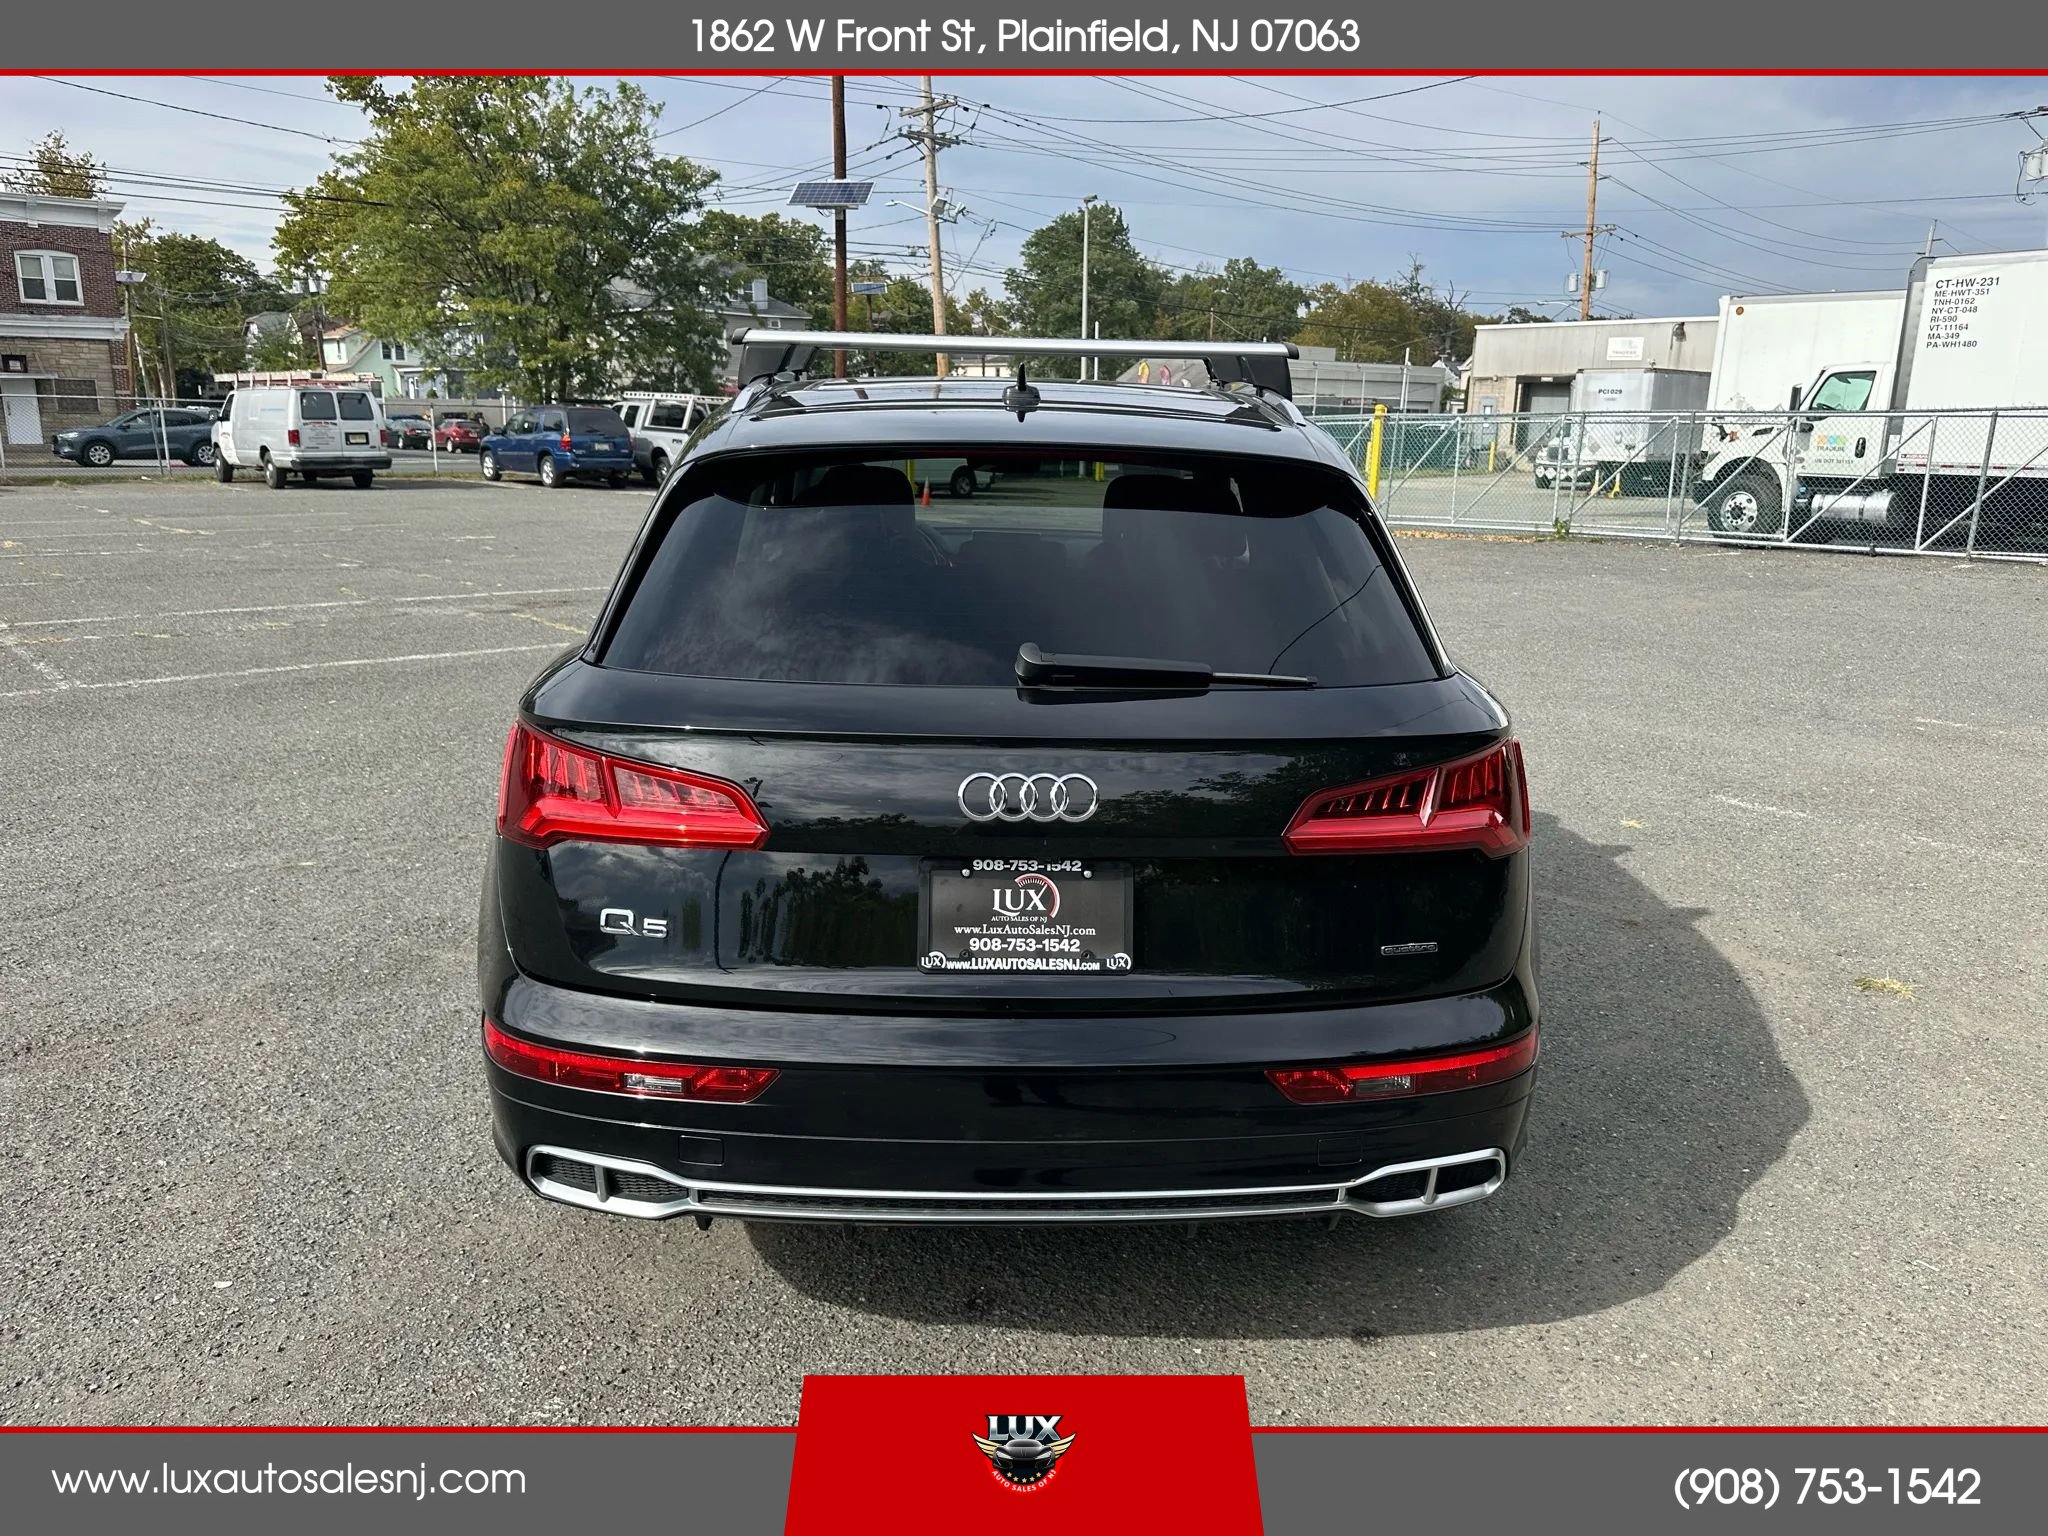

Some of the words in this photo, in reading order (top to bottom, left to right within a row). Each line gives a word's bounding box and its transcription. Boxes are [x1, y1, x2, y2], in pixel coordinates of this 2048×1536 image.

[1935, 277, 2000, 289] CT-HW-231
[1934, 288, 1990, 298] ME-HWT-351
[1933, 297, 1976, 306] TNH-0162
[1931, 306, 1978, 315] NY-CT-048
[1930, 315, 1958, 323] RI-590
[1929, 323, 1969, 331] VT-11164
[1927, 332, 1960, 340] MA-349
[1926, 340, 1978, 348] PA-WH1480
[973, 859, 1082, 872] 908-753-1542
[992, 888, 1047, 917] LUX
[600, 908, 668, 938] Q5
[954, 924, 1096, 937] www.LuxAutoSalesNJ.com
[969, 938, 1081, 952] 908-753-1542
[921, 956, 942, 968] LUX
[1106, 958, 1126, 969] LUX
